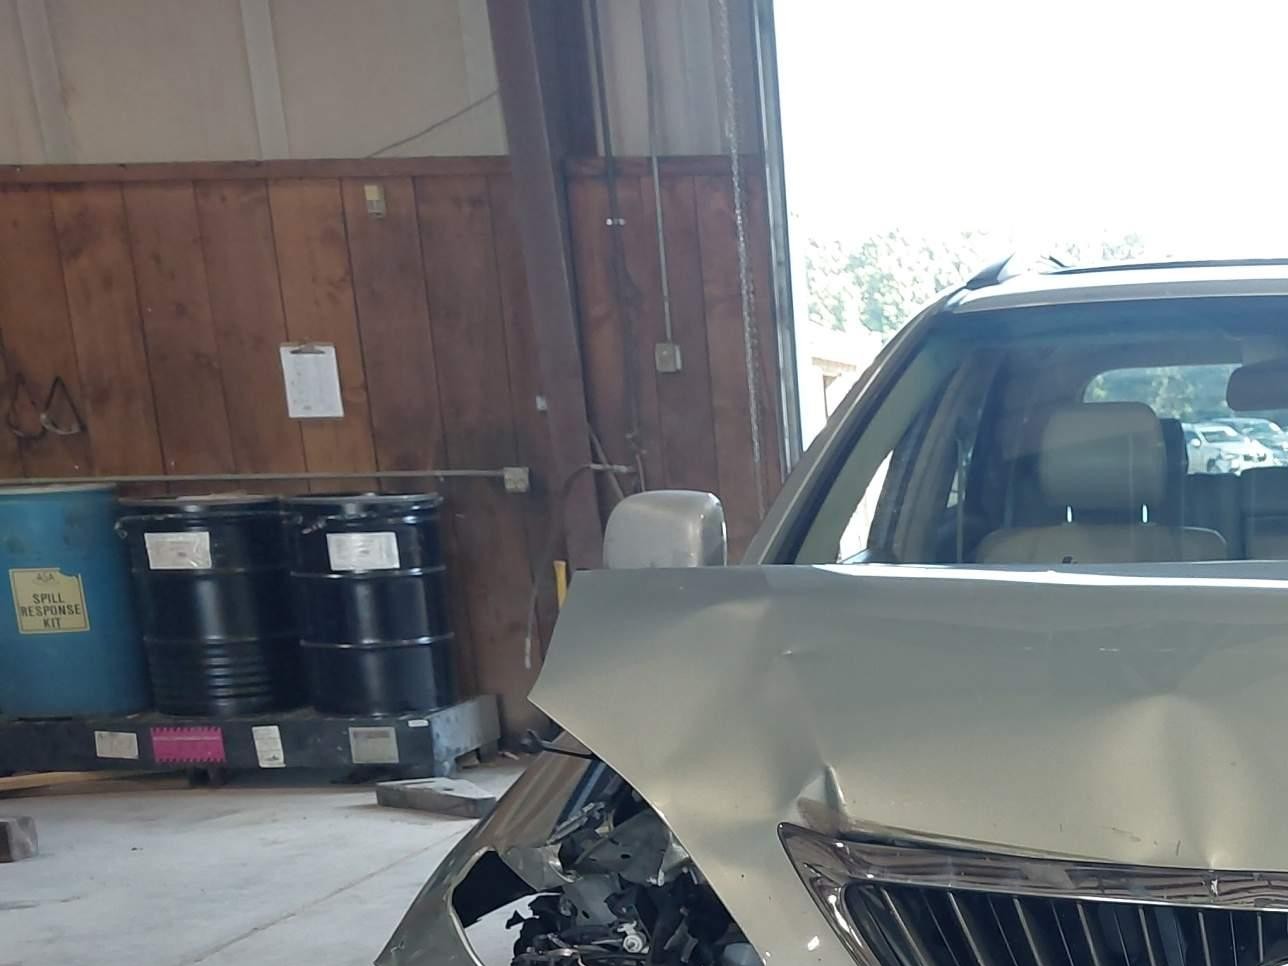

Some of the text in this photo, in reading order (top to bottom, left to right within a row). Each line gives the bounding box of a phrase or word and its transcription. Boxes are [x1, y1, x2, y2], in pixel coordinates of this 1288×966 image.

[32, 592, 65, 605] SPILL
[20, 603, 82, 617] RESPONSE
[43, 617, 62, 629] KIT
